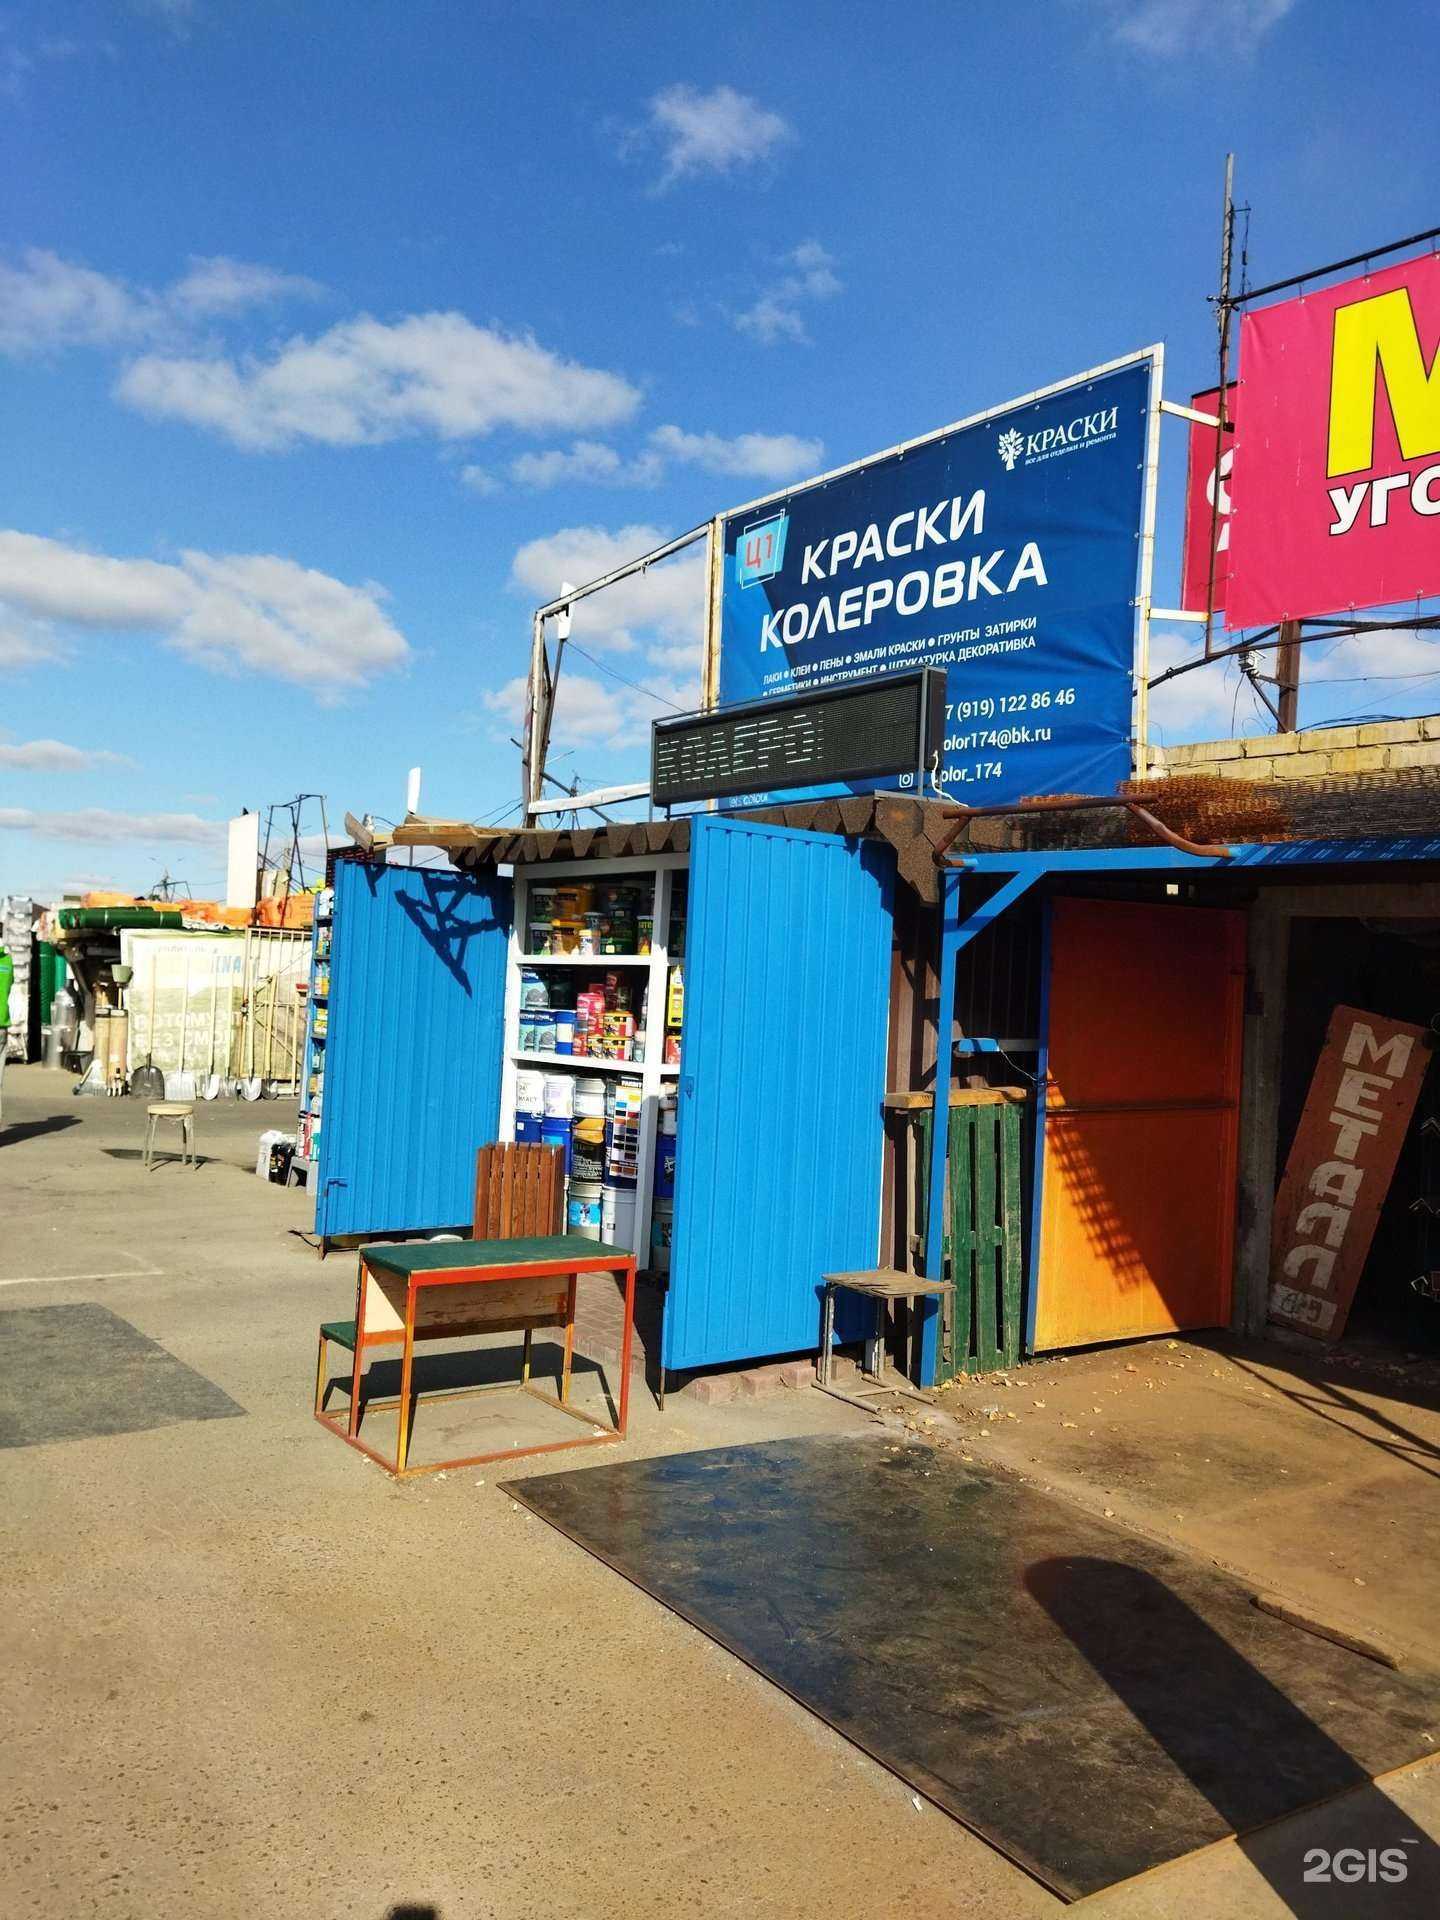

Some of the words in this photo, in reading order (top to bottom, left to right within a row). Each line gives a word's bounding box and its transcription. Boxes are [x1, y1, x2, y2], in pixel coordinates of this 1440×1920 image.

[1025, 406, 1119, 456] КРАСКИ
[1050, 443, 1078, 458] отделки
[1085, 432, 1117, 449] ремонта
[801, 489, 986, 585] КРАСКИ
[759, 541, 1049, 653] КОЛЕРОВКА
[763, 671, 782, 685] ЛАКИ
[790, 665, 811, 679] КЛЕИ
[819, 656, 844, 672] ПЕНЫ
[853, 646, 887, 663] ЭМАЛИ
[888, 637, 926, 656] КРАСКИ
[937, 627, 980, 647] ГРУНТЫ
[984, 616, 1037, 637] ЗАТИРКИ
[957, 635, 1036, 663] ДЕКОРАТИВКА
[957, 697, 995, 722] (919)
[999, 694, 1028, 714] 122
[1030, 691, 1050, 709] 86
[1054, 688, 1076, 706] 46
[943, 726, 1052, 751] olor174@bk.ru
[941, 762, 1002, 783] olor_174
[1283, 1021, 1416, 1291] МЕТАЛЛ
